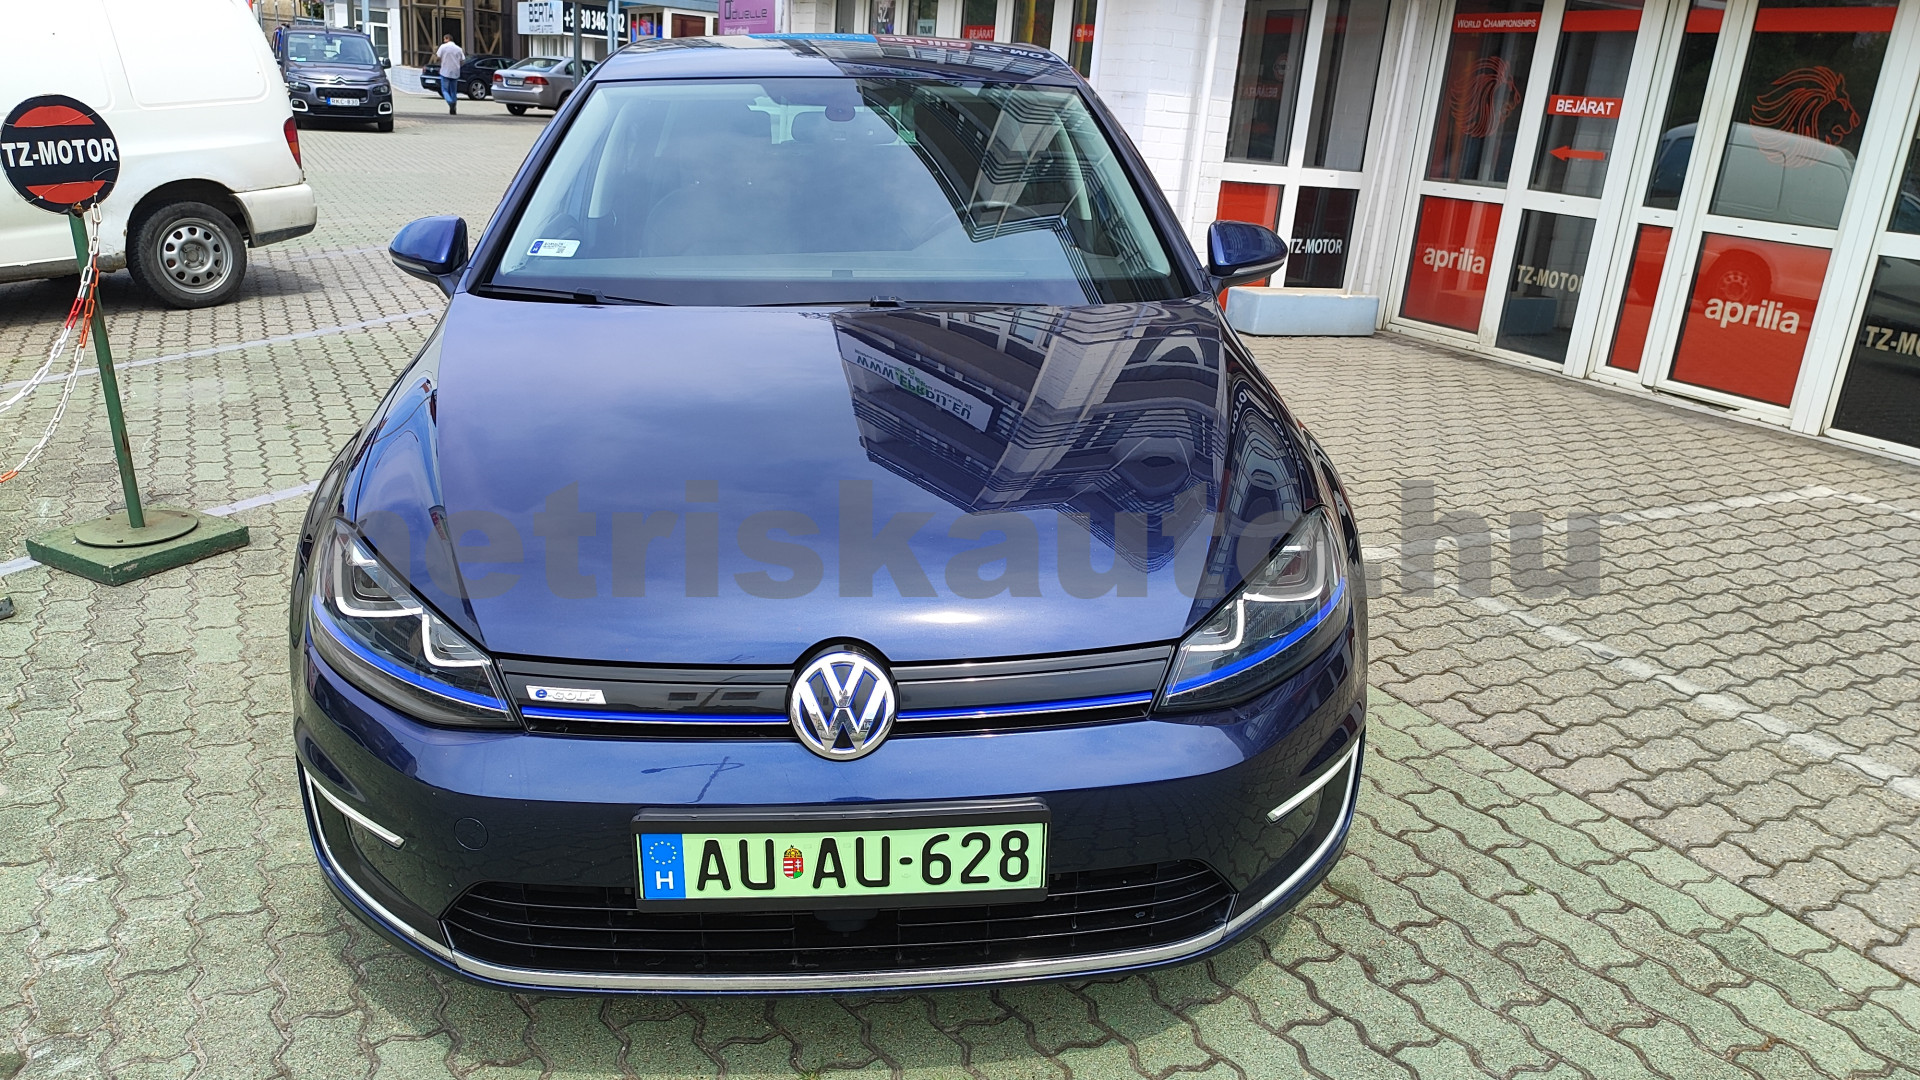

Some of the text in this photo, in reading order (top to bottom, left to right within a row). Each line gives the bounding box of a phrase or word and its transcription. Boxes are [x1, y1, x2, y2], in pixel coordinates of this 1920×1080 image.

[528, 2, 554, 22] BERTA
[969, 26, 994, 40] BEJÁRAT
[1457, 18, 1537, 29] WORLD CHAMPIONSHIPS
[1555, 97, 1615, 116] BEJÁRAT
[1, 138, 118, 168] TZ-MOTOR
[1290, 238, 1342, 254] TZ-MOTOR
[1422, 247, 1486, 275] aprilia
[1704, 298, 1801, 335] aprilia
[696, 829, 1029, 891] AU AU-628
[655, 870, 674, 890] H
